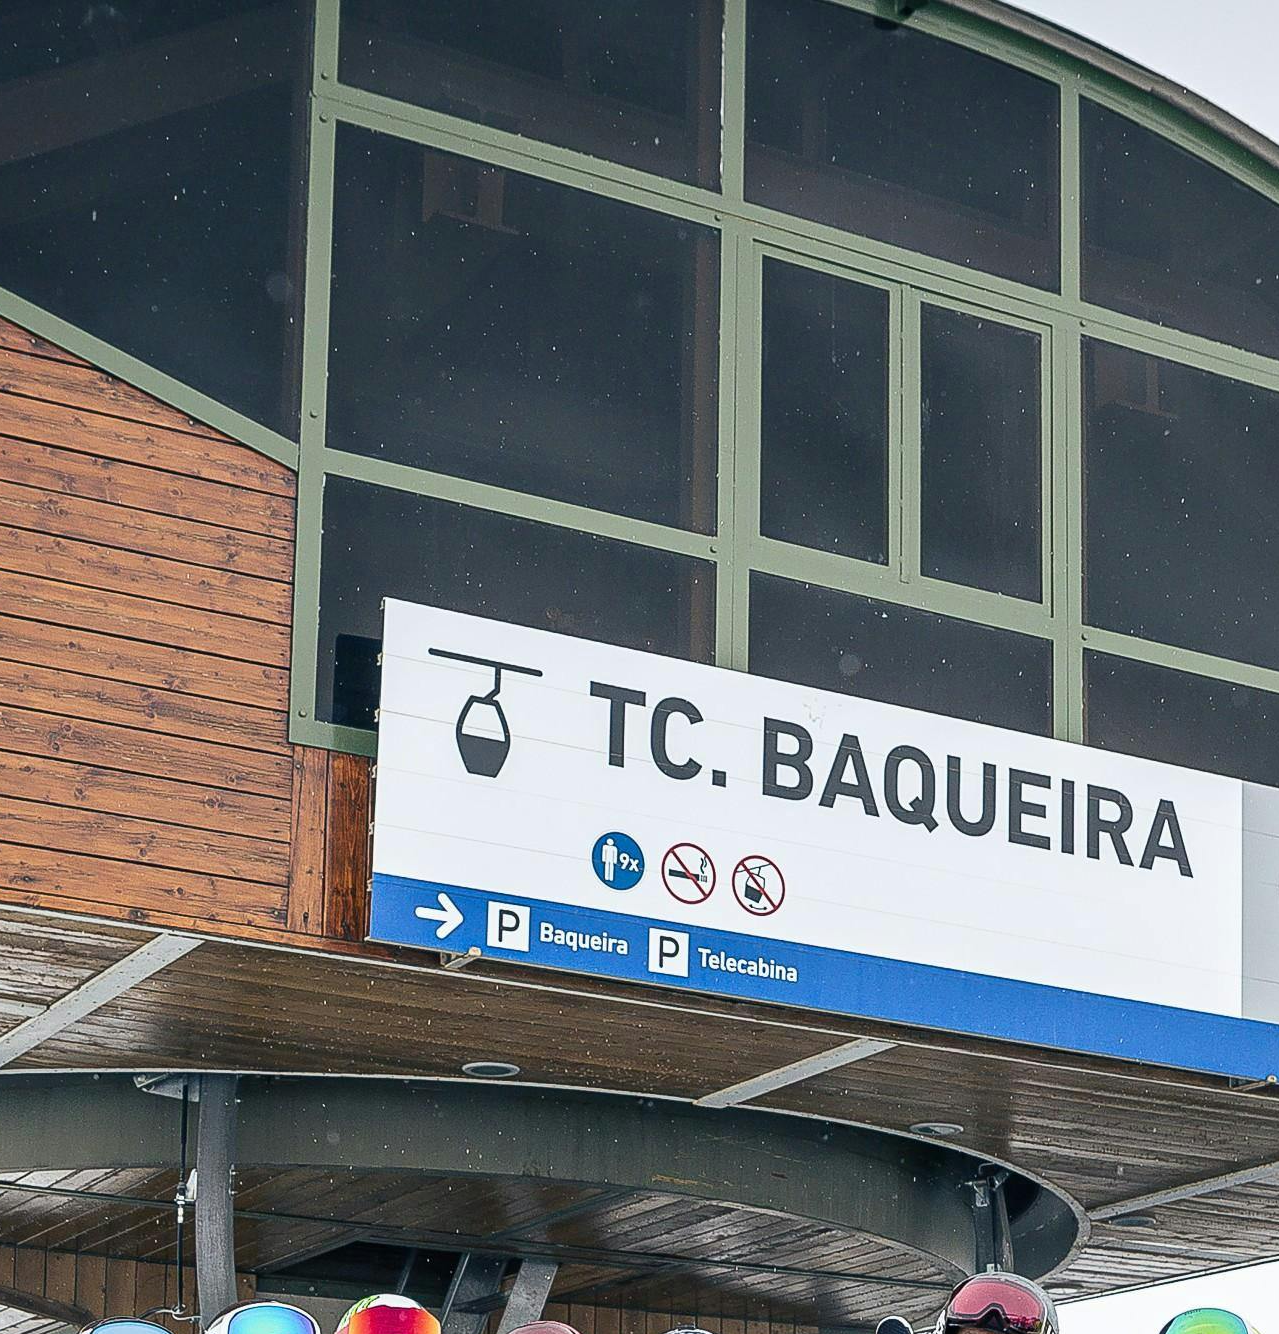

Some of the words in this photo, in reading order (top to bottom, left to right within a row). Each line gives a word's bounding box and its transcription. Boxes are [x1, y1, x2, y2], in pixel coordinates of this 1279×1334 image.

[589, 680, 727, 788] TC.
[762, 715, 1194, 879] BAQUEIRA
[618, 852, 640, 872] 9x
[539, 921, 629, 955] Baqueira
[696, 946, 799, 983] Telecabina
